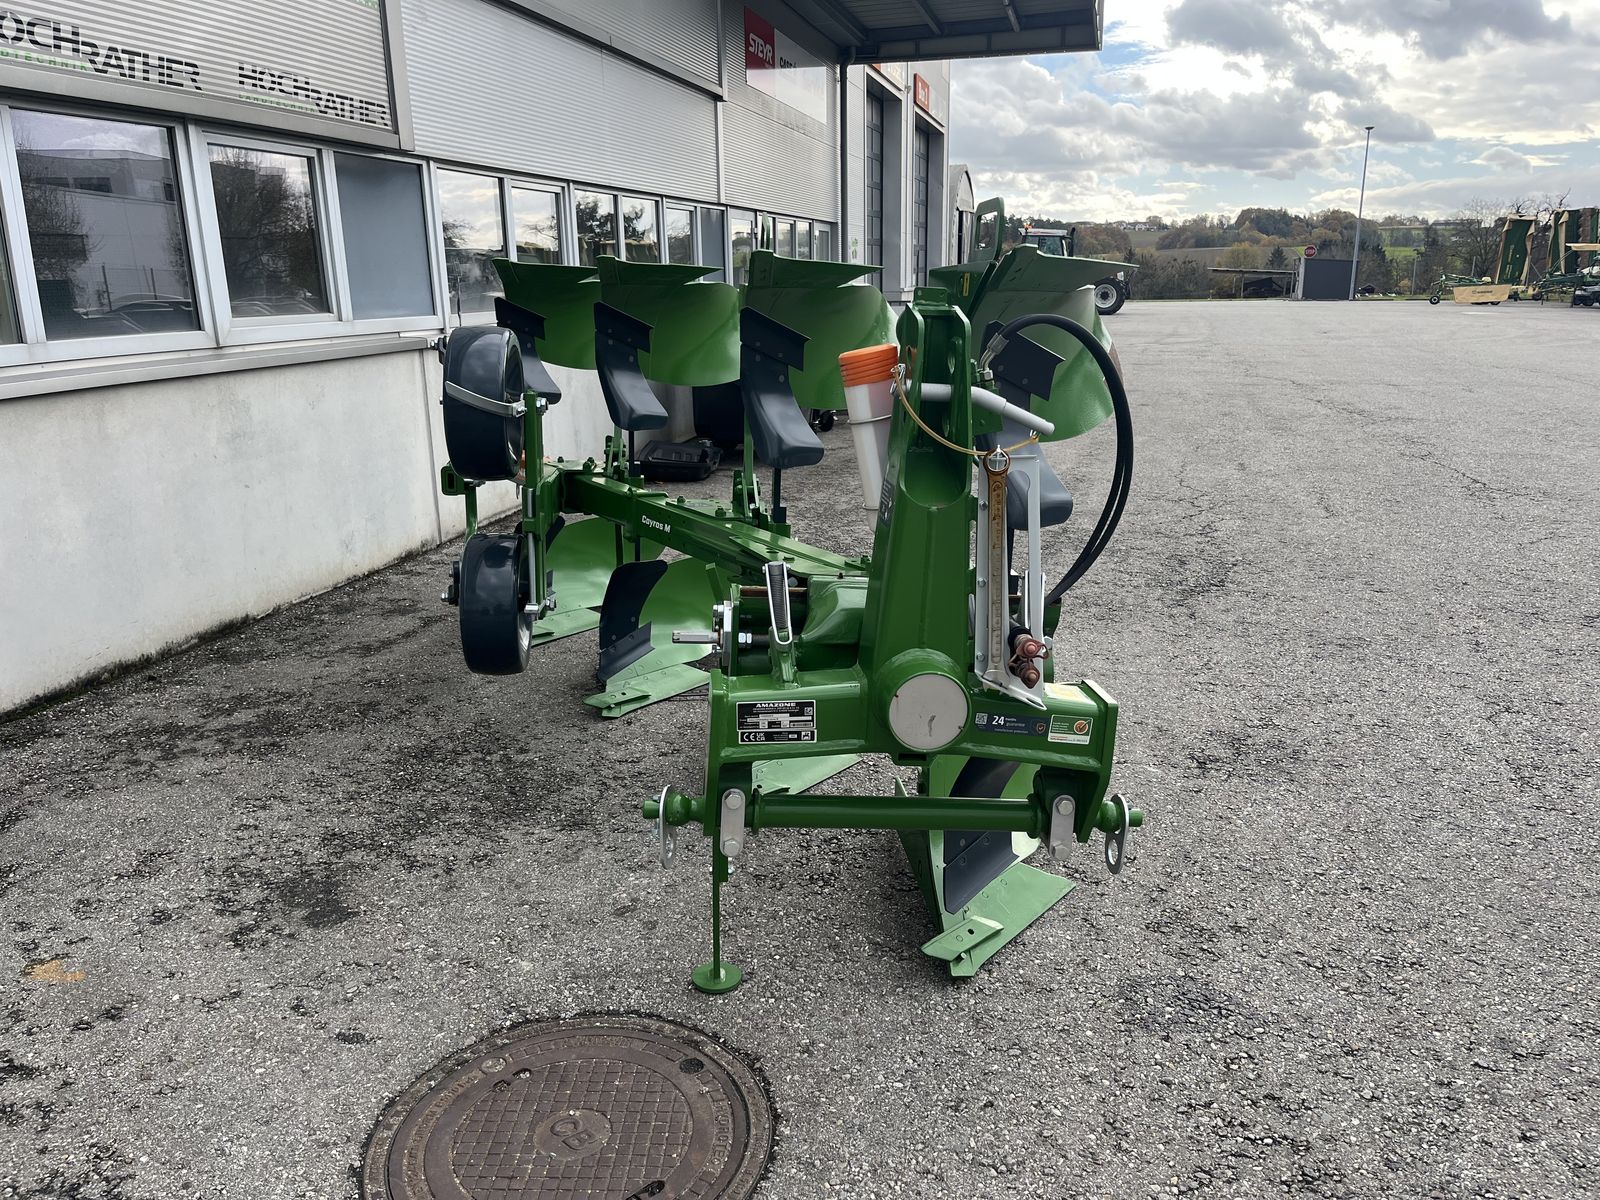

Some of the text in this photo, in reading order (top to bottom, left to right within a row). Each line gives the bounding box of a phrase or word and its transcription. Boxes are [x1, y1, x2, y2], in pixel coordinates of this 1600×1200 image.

[748, 32, 773, 65] STEYR
[238, 62, 389, 127] HOCHRATHER
[238, 93, 316, 113] LANDTECHNIK
[641, 514, 671, 533] Cayros M
[991, 715, 1005, 726] 24
